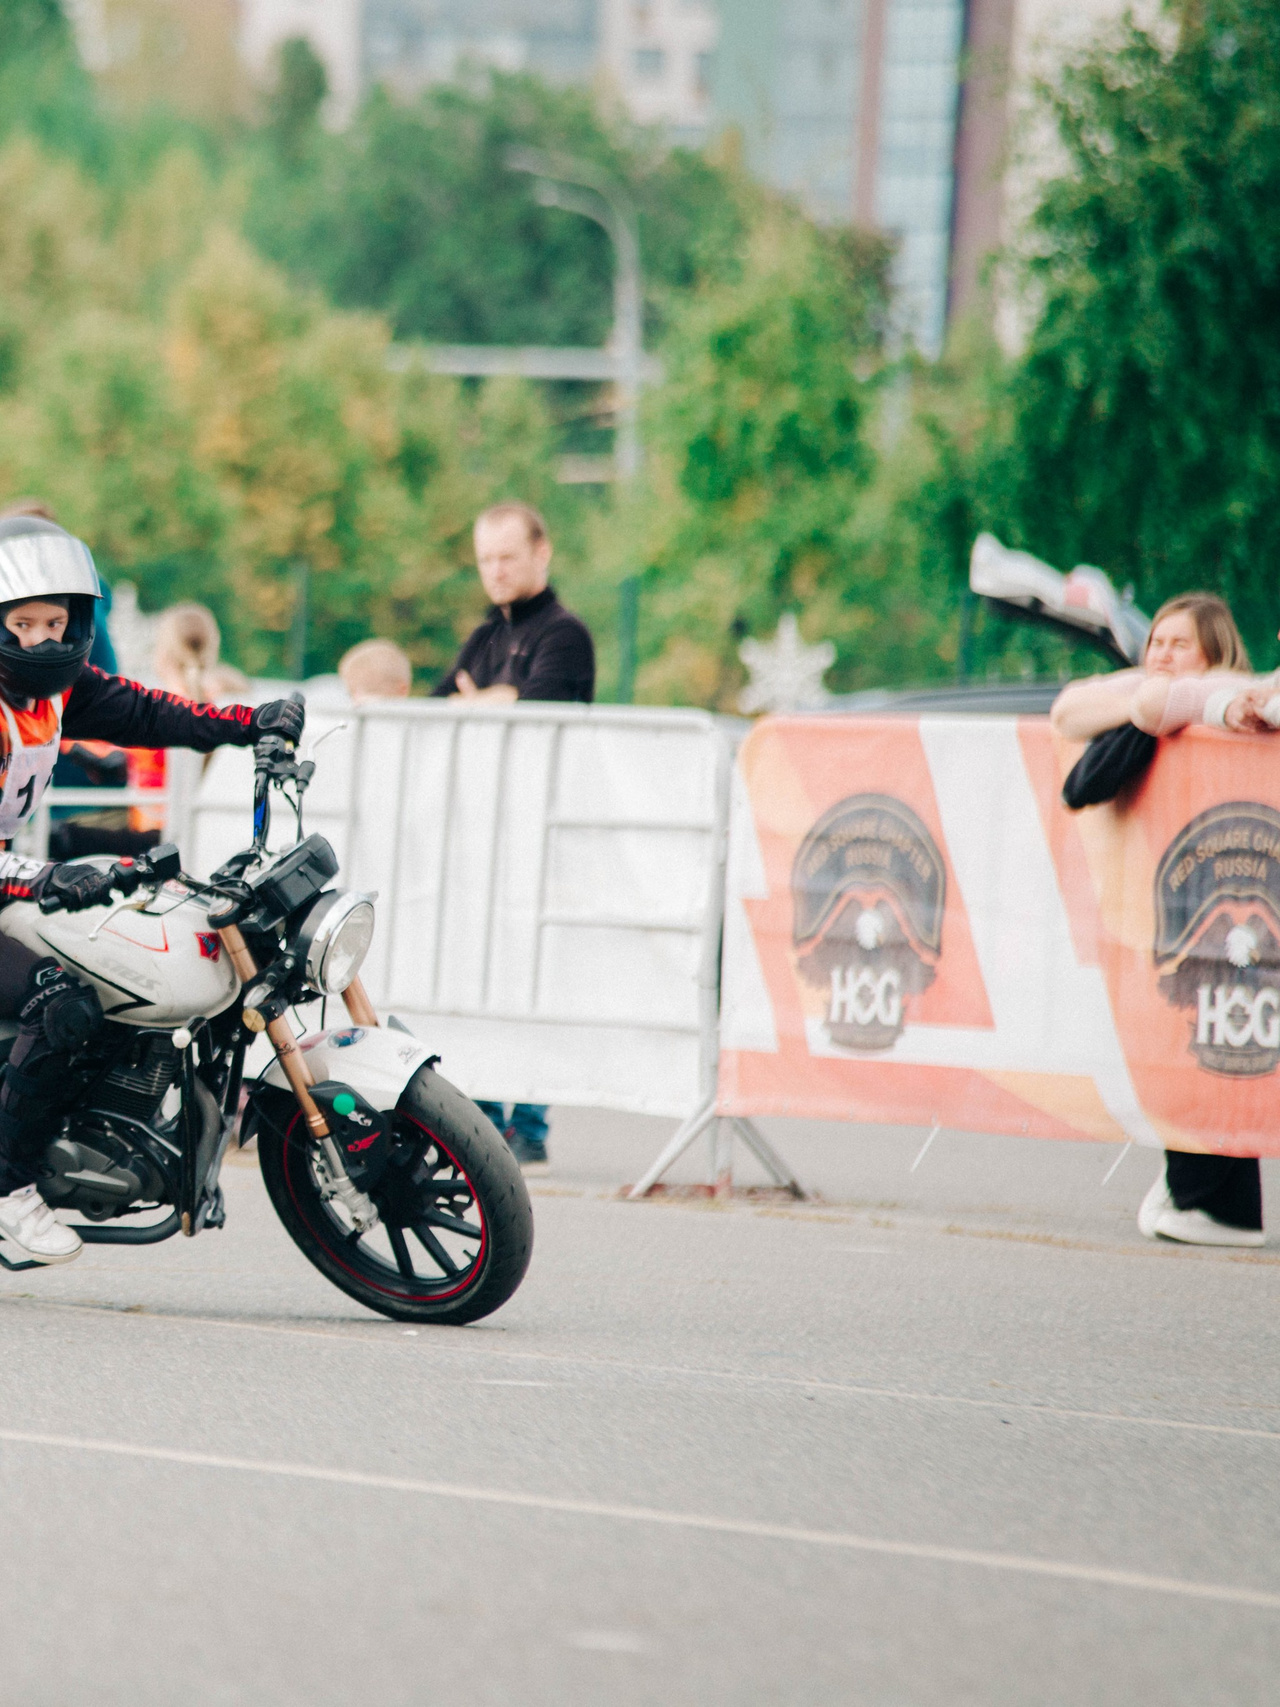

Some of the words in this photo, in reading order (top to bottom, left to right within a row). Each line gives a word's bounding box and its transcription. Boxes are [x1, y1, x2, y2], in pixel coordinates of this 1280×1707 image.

[845, 843, 892, 869] RUSSIA
[1169, 853, 1196, 892] RED
[1196, 829, 1251, 863] SQUARE
[1214, 858, 1267, 881] RUSSIA
[830, 966, 900, 1026] HOG
[1197, 984, 1280, 1048] HOG
